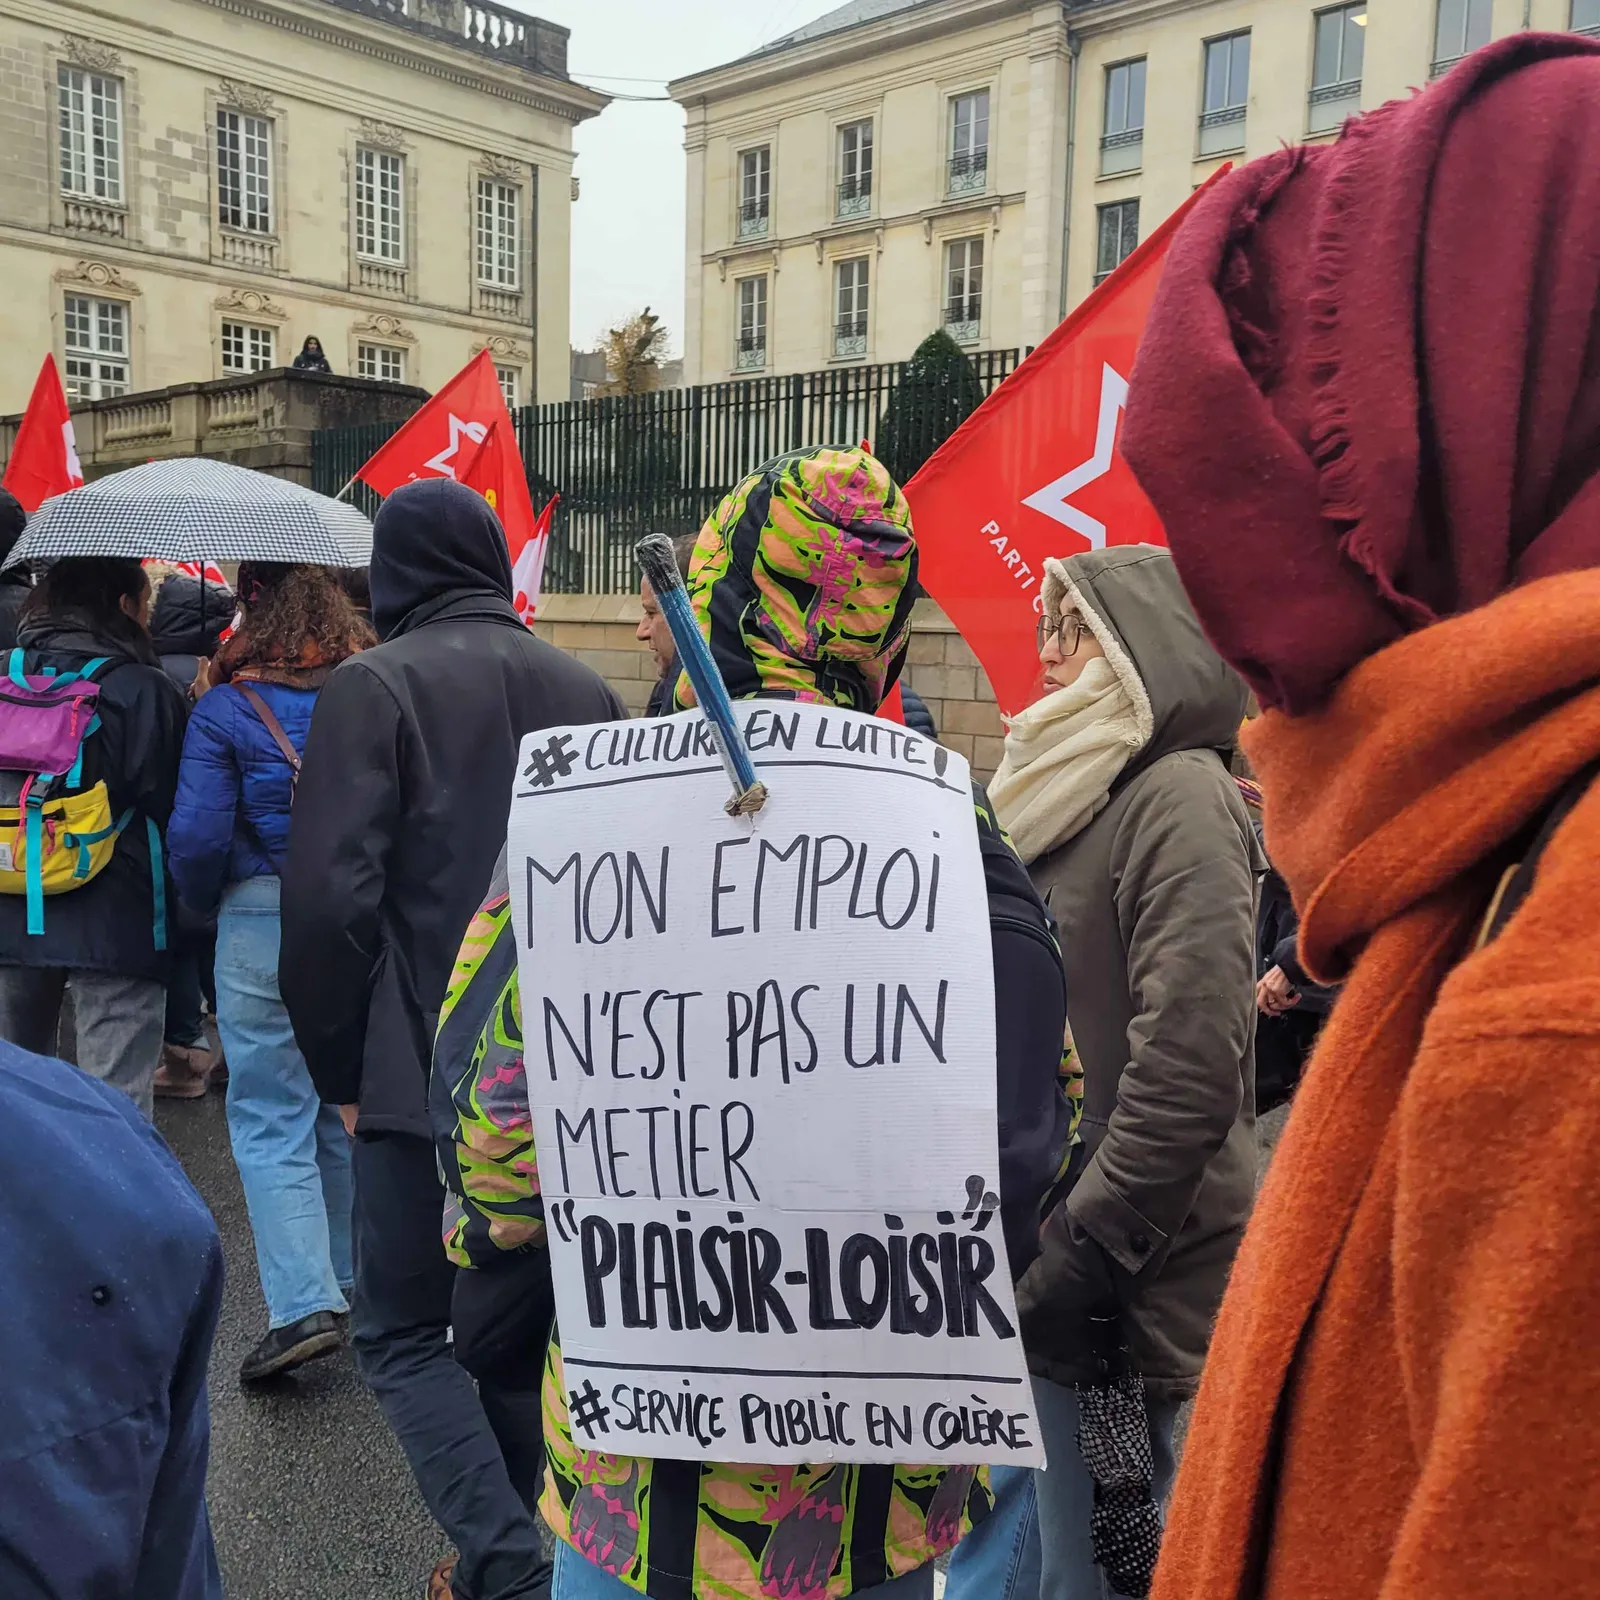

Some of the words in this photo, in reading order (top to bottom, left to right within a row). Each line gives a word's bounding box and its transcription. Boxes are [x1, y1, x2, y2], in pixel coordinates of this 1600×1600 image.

[980, 520, 1036, 589] PARTI
[523, 719, 720, 788] #CULTUR
[744, 709, 801, 752] EN
[526, 846, 669, 949] MON
[543, 991, 703, 1082] N'EST
[726, 979, 820, 1084] PAS
[844, 979, 948, 1068] UN
[867, 1401, 912, 1447] EN
[923, 1394, 1033, 1451] COLÈRE
